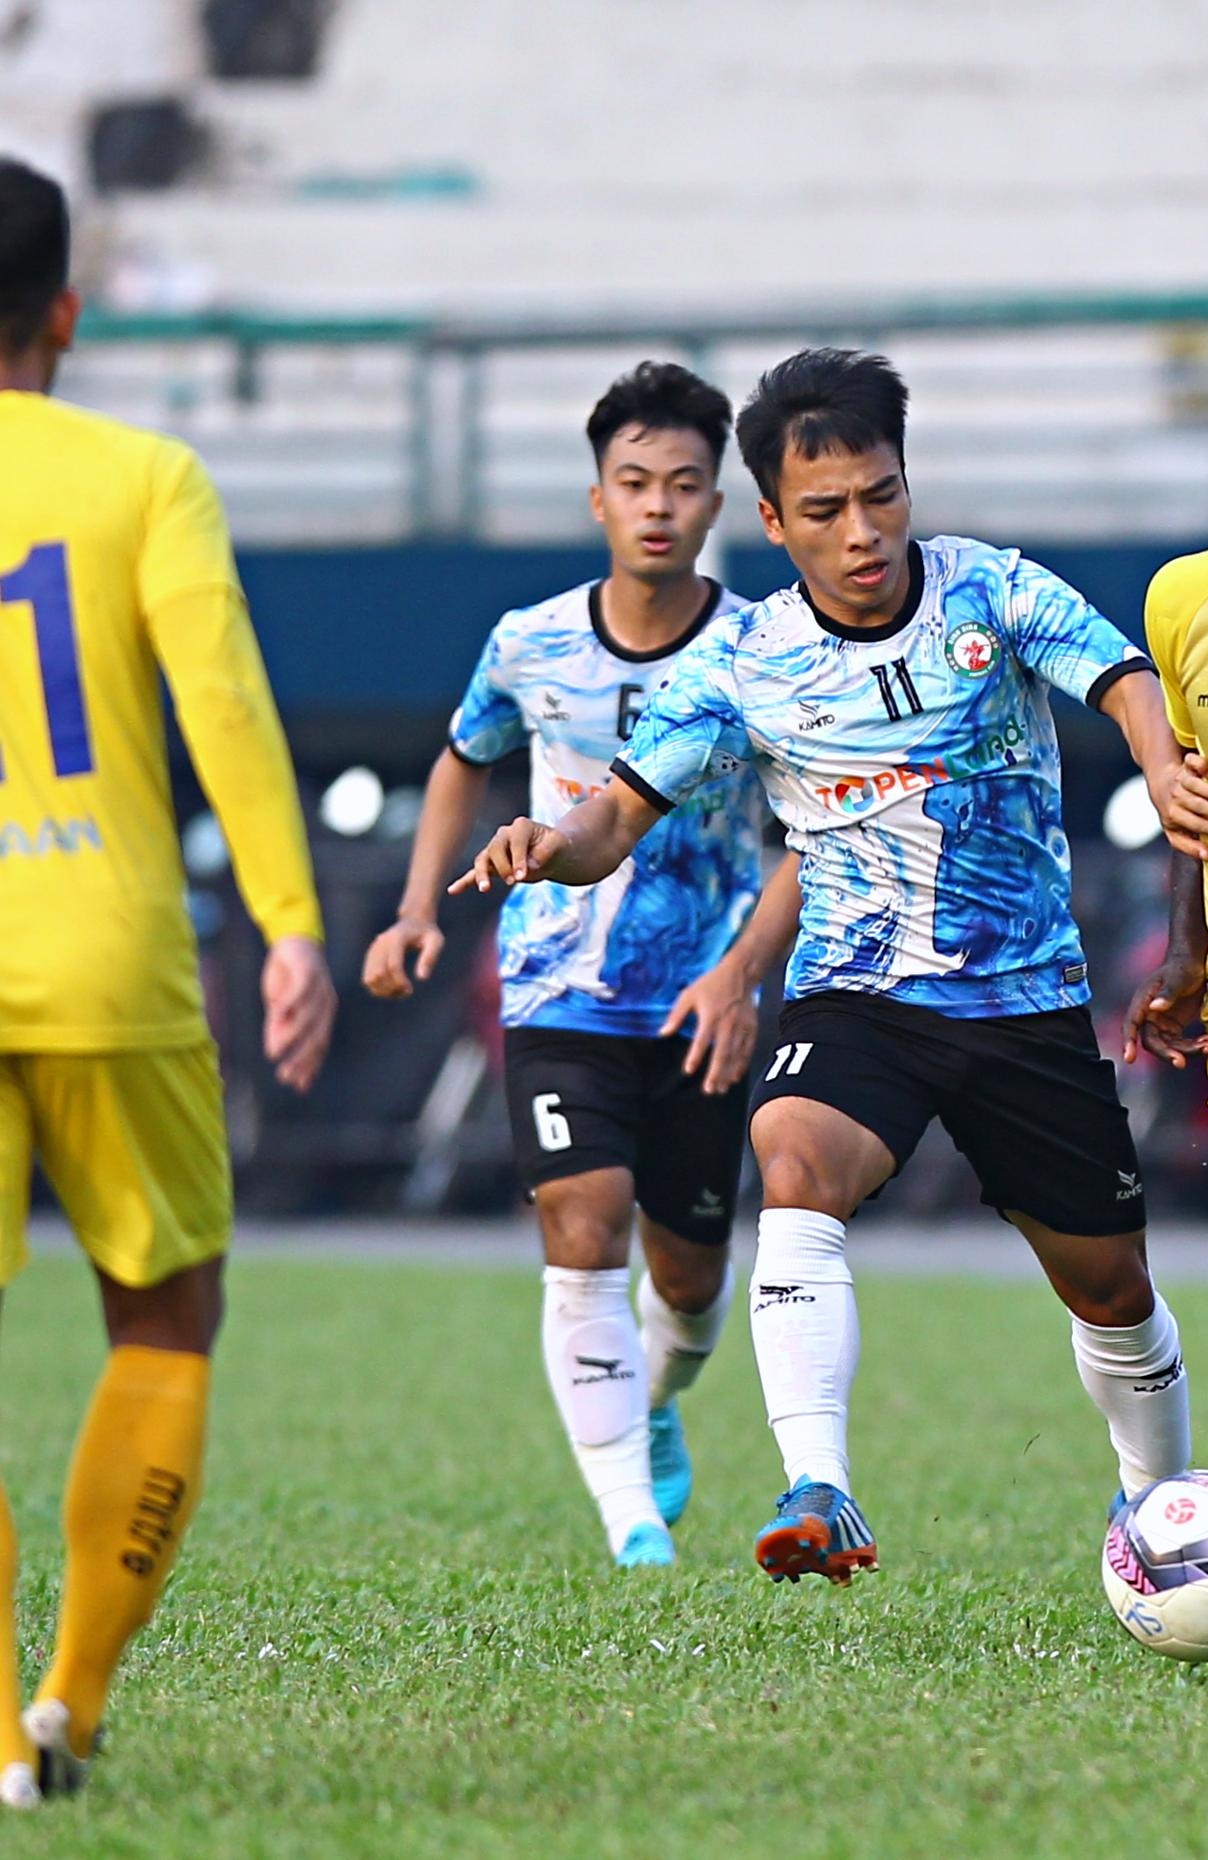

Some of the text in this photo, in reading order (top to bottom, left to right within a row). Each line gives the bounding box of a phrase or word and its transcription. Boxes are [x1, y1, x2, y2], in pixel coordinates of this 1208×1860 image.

[0, 541, 95, 785] 1
[870, 656, 924, 722] 11
[765, 1043, 814, 1082] 11
[533, 1093, 572, 1152] 6
